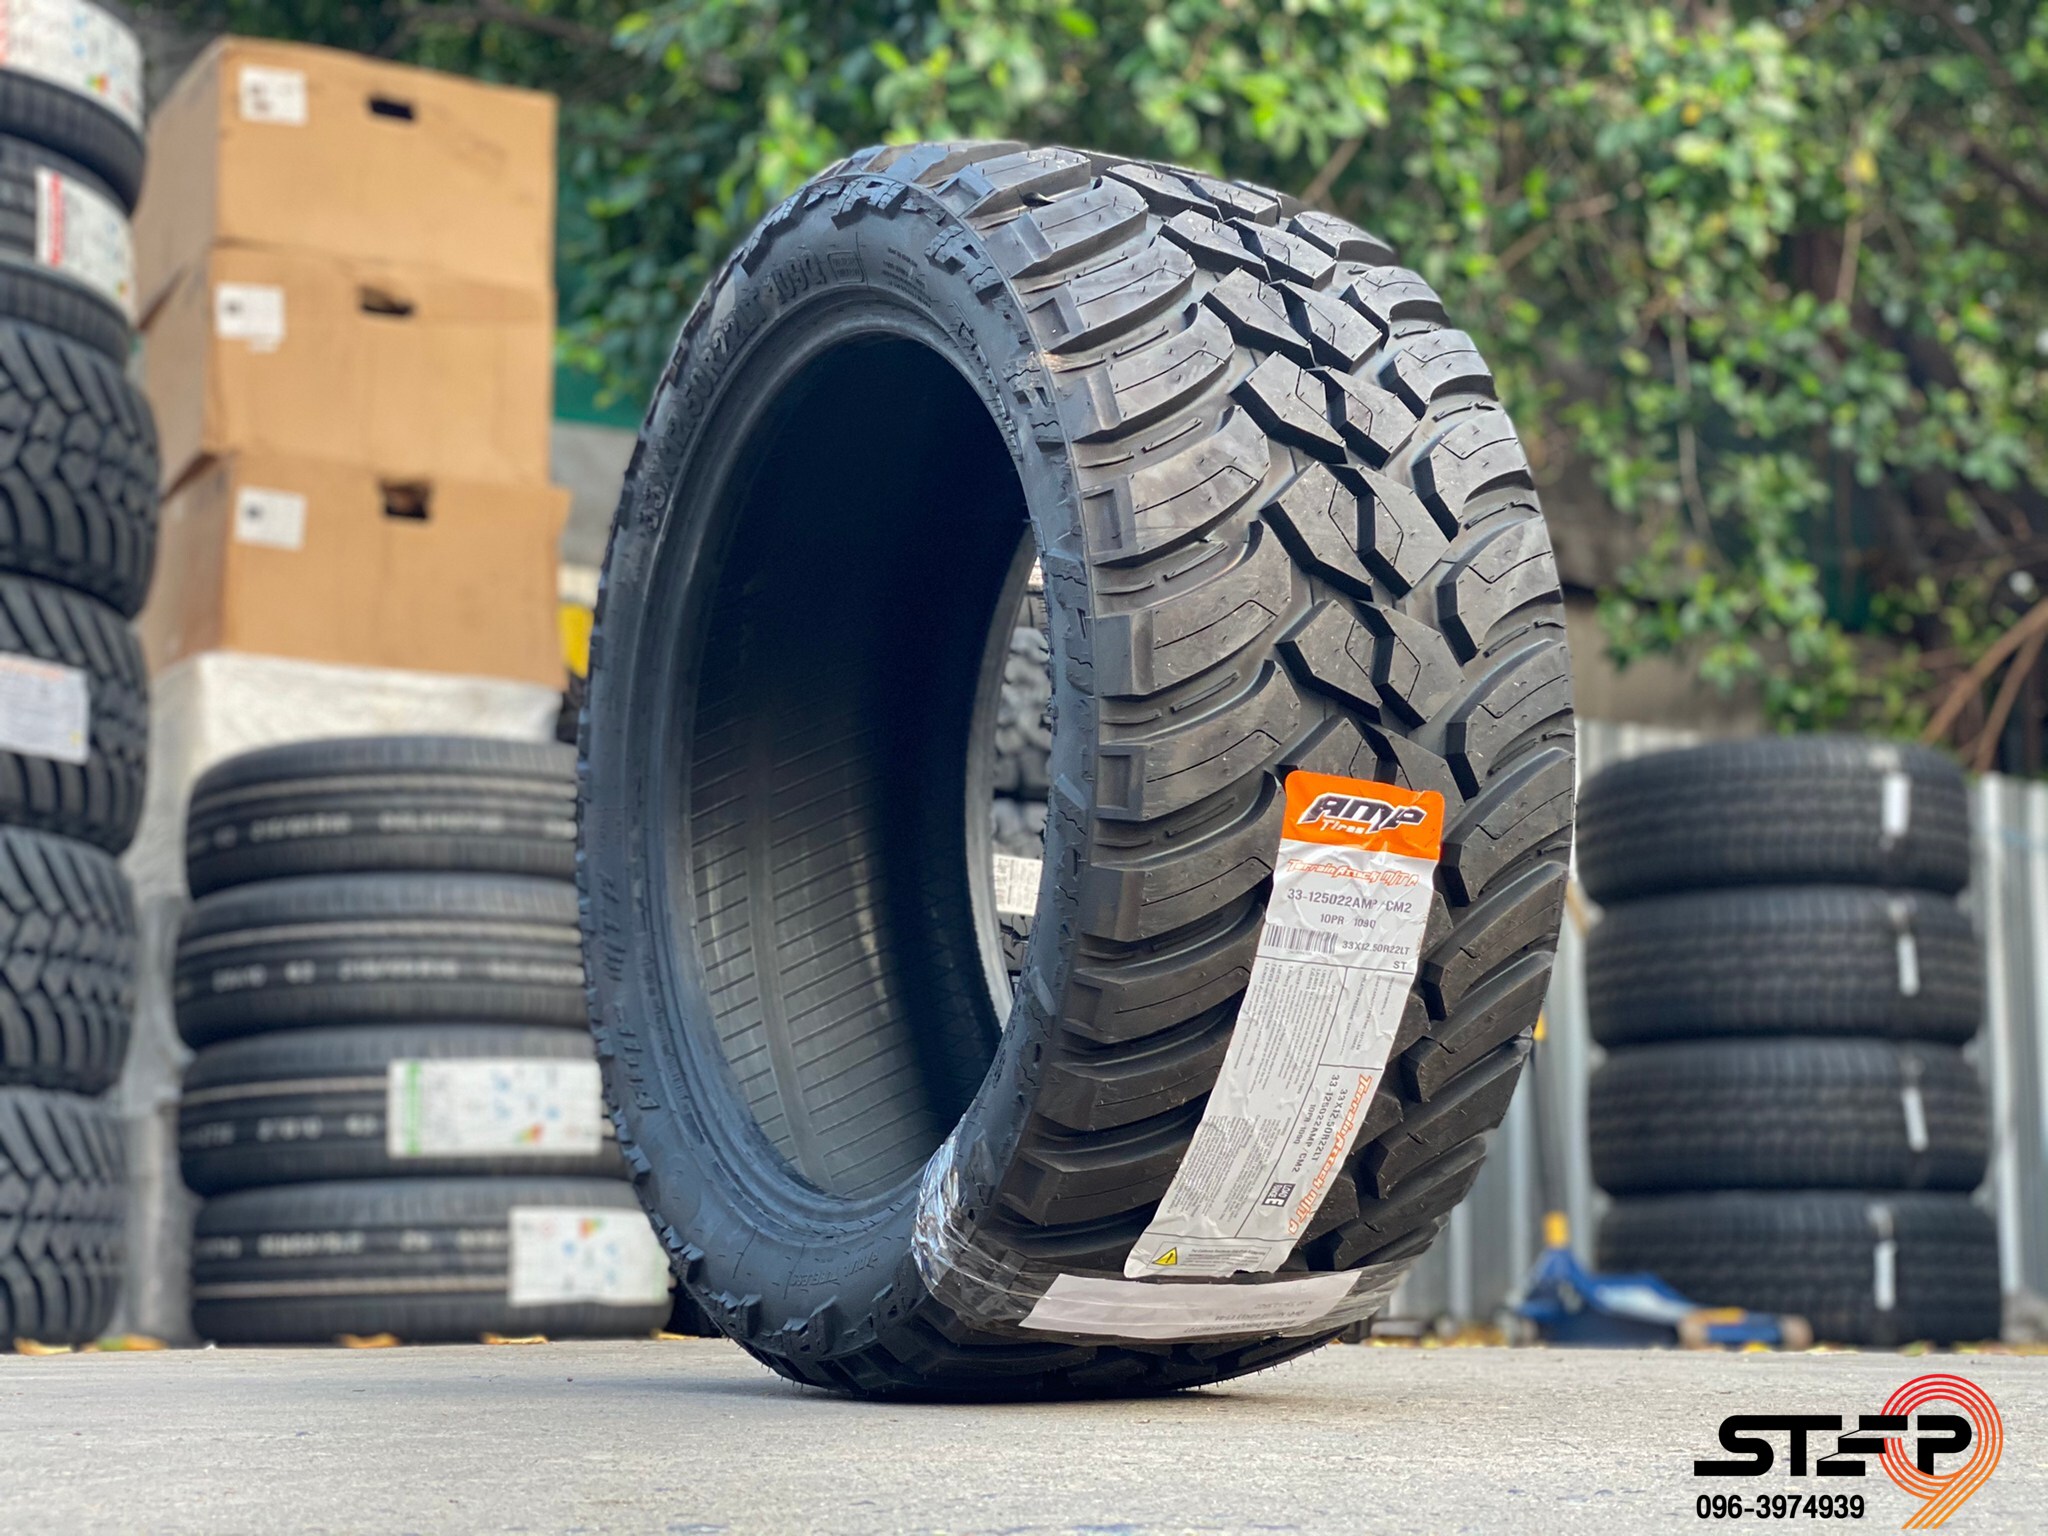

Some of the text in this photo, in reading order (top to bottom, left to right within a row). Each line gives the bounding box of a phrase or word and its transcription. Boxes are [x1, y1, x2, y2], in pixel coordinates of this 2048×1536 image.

[1297, 792, 1427, 834] AMP
[1320, 819, 1364, 834] Tires
[1320, 913, 1344, 925] 10PR
[1341, 940, 1410, 955] 33X12.50R22LT
[1392, 960, 1407, 970] ST
[1311, 1088, 1348, 1161] 33X12.50R22LT
